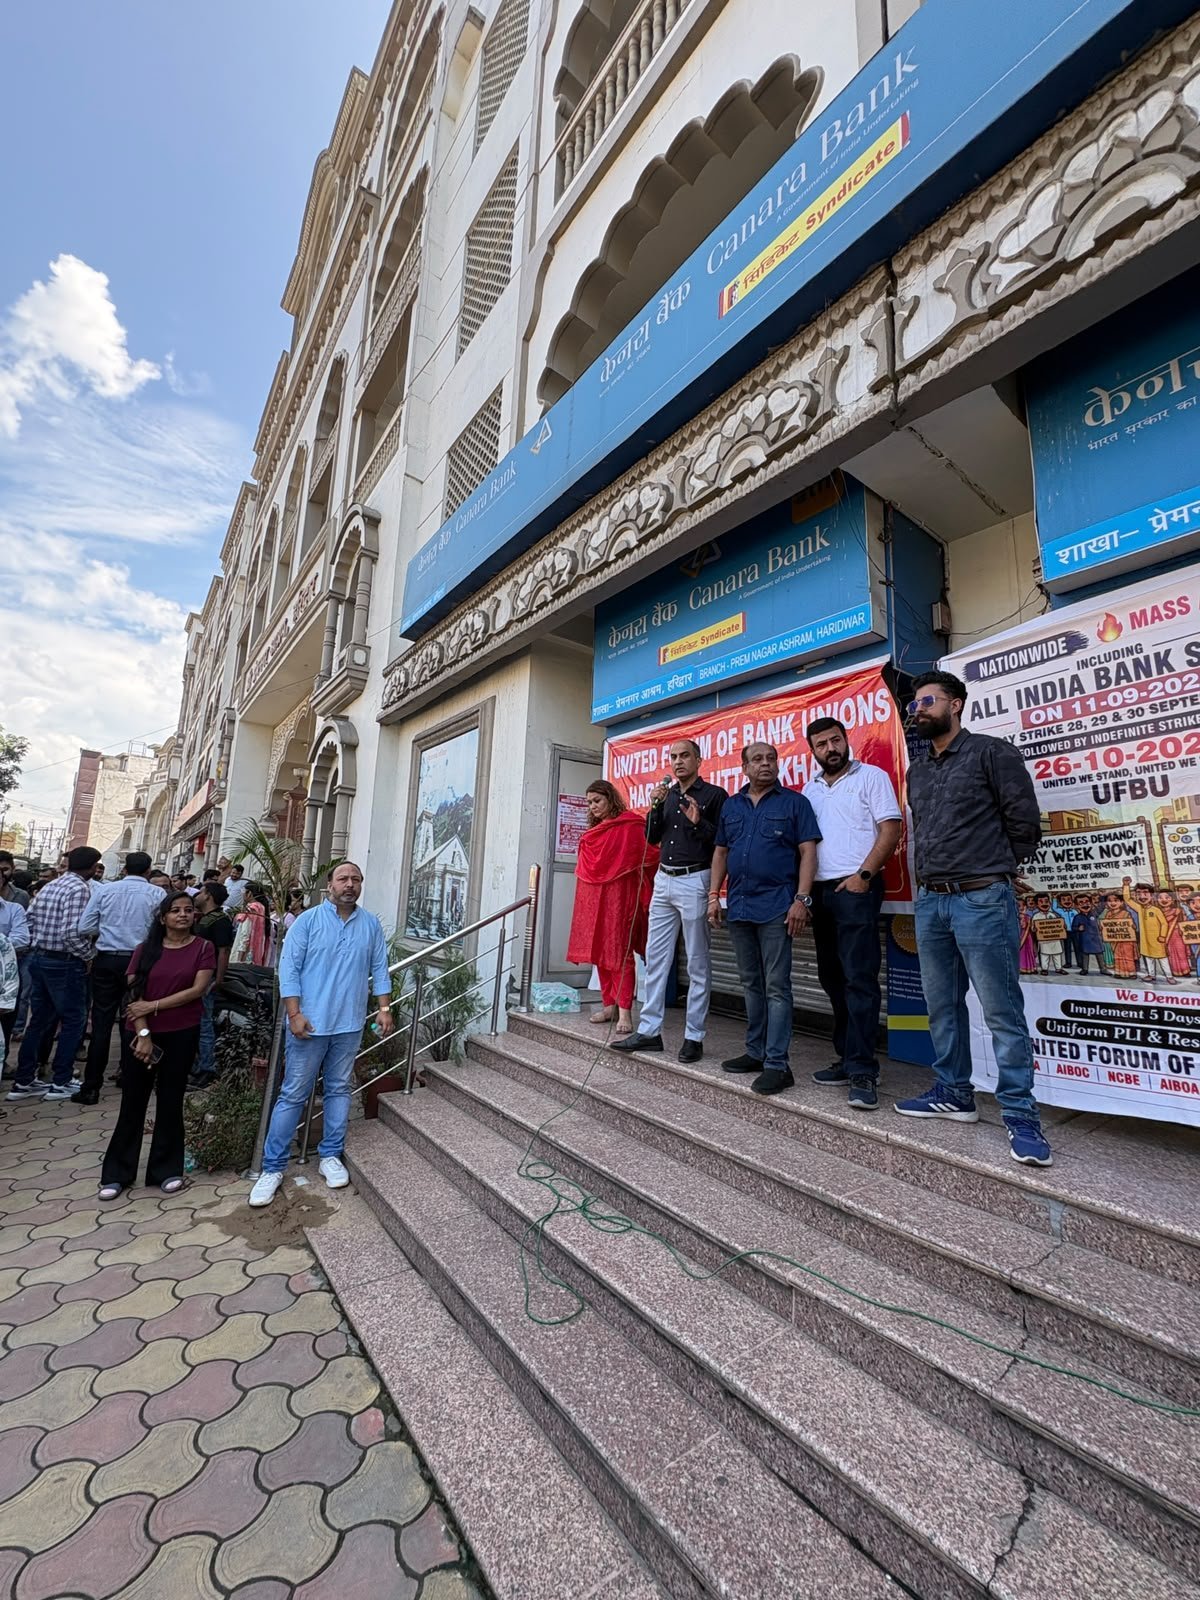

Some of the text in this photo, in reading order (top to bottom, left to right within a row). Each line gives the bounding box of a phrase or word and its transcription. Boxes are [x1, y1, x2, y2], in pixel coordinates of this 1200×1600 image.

[707, 45, 920, 275] Canara Bank
[783, 166, 830, 217] Government
[830, 154, 840, 169] of
[839, 136, 862, 159] India
[863, 78, 920, 136] Undertaking
[742, 139, 895, 291] सिंडिकेट Syndicate
[600, 317, 651, 383] केनरा
[656, 276, 691, 325] बैंक
[1087, 395, 1198, 451] भारत सरकार का
[455, 492, 488, 534] Canara
[490, 460, 517, 499] Bank
[689, 525, 831, 610] Canara Bank
[743, 580, 775, 600] Government
[781, 571, 795, 582] India
[795, 554, 832, 575] Undertaking
[607, 614, 648, 649] केनरा
[651, 600, 678, 627] बैंक
[1129, 595, 1191, 630] MASS
[699, 663, 726, 680] BRANCH
[730, 653, 751, 669] PREM
[751, 644, 778, 661] NAGAR
[778, 633, 815, 652] ASHRAM,
[816, 612, 865, 640] HARIDWAR
[700, 622, 740, 645] Syndicate
[979, 636, 1068, 679] NATIONWIDE
[1077, 643, 1144, 671] INCLUDING
[615, 692, 640, 709] प्रेमनगर
[666, 672, 693, 692] हरिद्वार
[970, 694, 1009, 722] ALL
[1015, 672, 1086, 711] INDIA
[1093, 648, 1176, 691] BANK
[1029, 673, 1200, 725] ON 11-09-202
[1019, 724, 1065, 743] STRIKE
[1067, 720, 1088, 732] 28,
[1091, 715, 1108, 727] 29
[1111, 711, 1123, 723] &
[1127, 706, 1145, 719] 30
[1148, 692, 1200, 714] SEPTE
[1074, 736, 1087, 749] BY
[1090, 722, 1156, 745] INDEFINITE
[1160, 715, 1200, 732] STRIKE
[613, 748, 658, 779] UNITED
[716, 726, 738, 758] OF
[743, 712, 796, 748] BANK
[1034, 731, 1200, 780] 26-10-202
[1043, 758, 1197, 790] UNITED WE STAND, UNITED WE
[1091, 774, 1171, 805] UFBU
[1052, 847, 1095, 863] WEEK
[1099, 839, 1145, 859] NOW!
[1091, 830, 1138, 844] DEMAND:
[1040, 874, 1055, 882] STOP
[1089, 871, 1110, 879] GRIND
[1080, 862, 1092, 871] का
[1070, 1003, 1200, 1026] Implement 5 Days
[1115, 989, 1139, 1002] We
[1046, 1020, 1200, 1048] Uniform PLI & Res
[1031, 1038, 1196, 1076] NITED FORUM OF
[1056, 1063, 1090, 1079] AIBOC
[1107, 1070, 1141, 1086] NCBE
[1160, 1078, 1200, 1095] AIBOA
